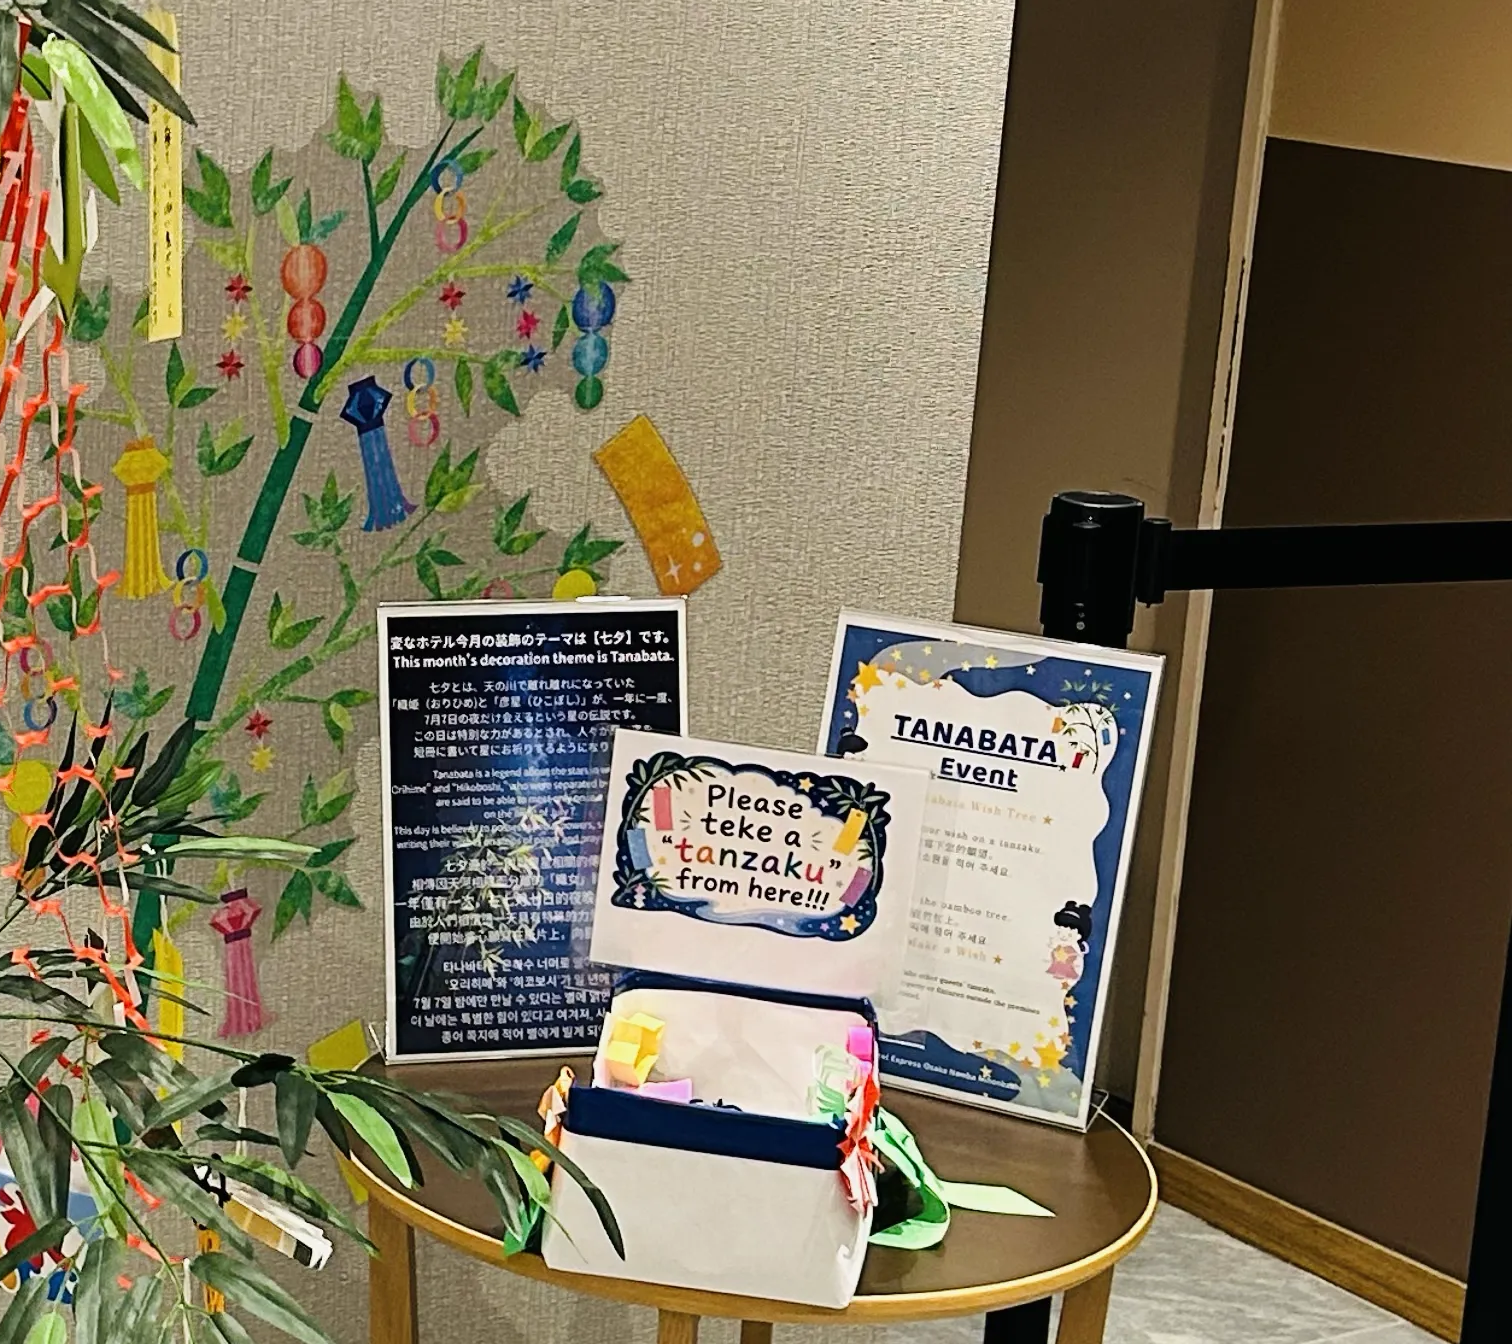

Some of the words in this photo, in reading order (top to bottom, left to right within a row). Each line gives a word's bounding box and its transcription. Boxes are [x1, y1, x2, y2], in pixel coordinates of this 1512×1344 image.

[393, 655, 421, 668] This
[423, 653, 477, 667] month's
[480, 651, 550, 666] decoration
[553, 651, 595, 664] theme
[597, 650, 608, 663] is
[610, 649, 675, 664] Tanabata.
[895, 714, 1057, 762] TANABATA
[433, 769, 474, 779] Tanabata
[475, 768, 483, 778] is
[492, 767, 521, 779] legend
[940, 757, 1018, 787] Event
[433, 783, 450, 793] and
[436, 798, 450, 806] are
[452, 796, 470, 806] said
[472, 797, 481, 805] to
[483, 796, 494, 805] be
[496, 796, 516, 805] able
[708, 784, 803, 819] Please
[483, 811, 496, 819] on
[971, 800, 1002, 816] Wish
[1007, 807, 1037, 823] Tree
[394, 826, 412, 835] This
[413, 826, 430, 836] day
[432, 825, 439, 834] is
[701, 813, 773, 842] teke
[784, 830, 801, 848] a
[944, 829, 968, 840] wish
[972, 835, 985, 843] on
[397, 840, 427, 851] writing
[429, 839, 450, 849] their
[662, 835, 841, 884] "tanzaku"
[676, 867, 739, 896] from
[748, 877, 830, 911] here!!!
[956, 945, 986, 961] Wish
[516, 994, 526, 1006] 수
[529, 992, 562, 1005] 있다는
[565, 991, 586, 1004] 별에
[424, 1015, 458, 1027] 날에는
[461, 1012, 494, 1025] 특별한
[521, 1010, 554, 1023] 있다고
[502, 1028, 523, 1040] 적어
[527, 1026, 559, 1040] 별에게
[587, 1024, 601, 1036] 되
[891, 1055, 921, 1068] Express
[923, 1062, 948, 1075] Osaka
[949, 1068, 976, 1081] Namba
